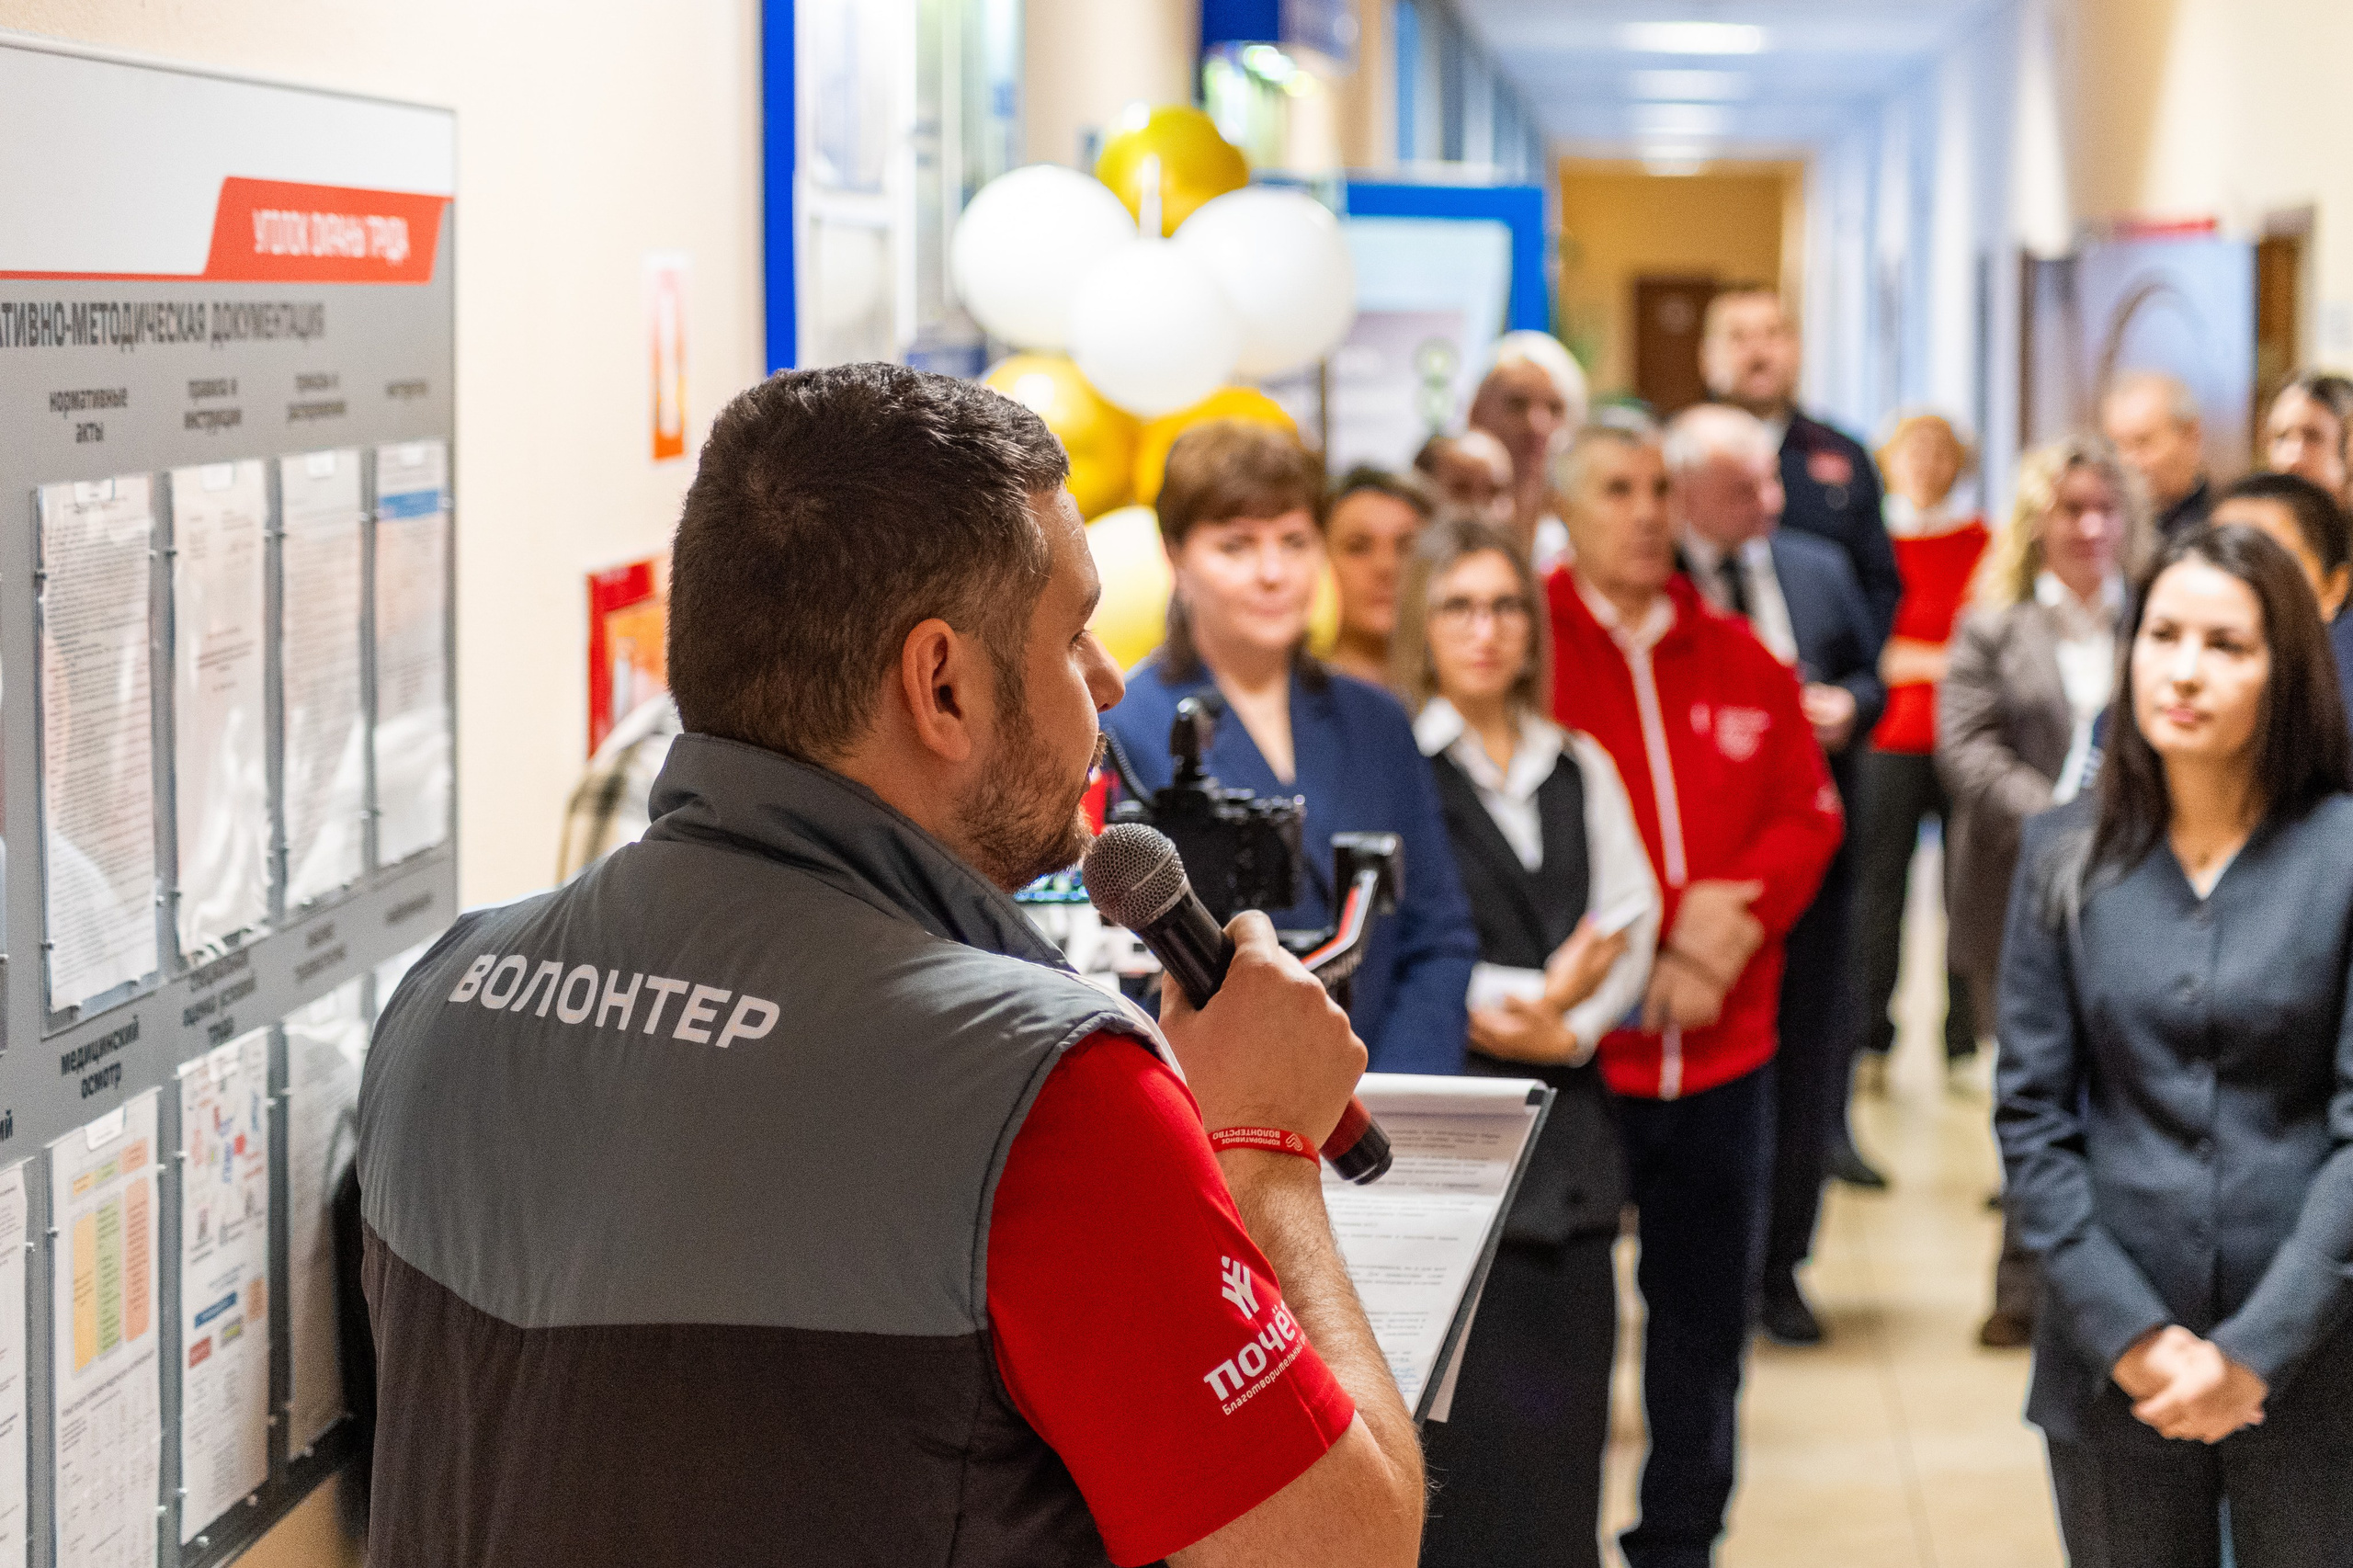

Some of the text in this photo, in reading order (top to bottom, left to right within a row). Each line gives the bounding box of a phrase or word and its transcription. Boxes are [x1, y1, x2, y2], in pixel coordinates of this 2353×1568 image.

[0, 301, 206, 352] ТИВНО-МЕТОДИЧЕСКАЯ
[448, 954, 780, 1049] ВОЛОНТЕР
[81, 1062, 122, 1099] осмотр
[1212, 1129, 1280, 1140] ВОЛОНТЕРСТВО
[1221, 1137, 1280, 1146] КОРПОРАТИВНОЕ
[1222, 1339, 1303, 1415] Благотворительный
